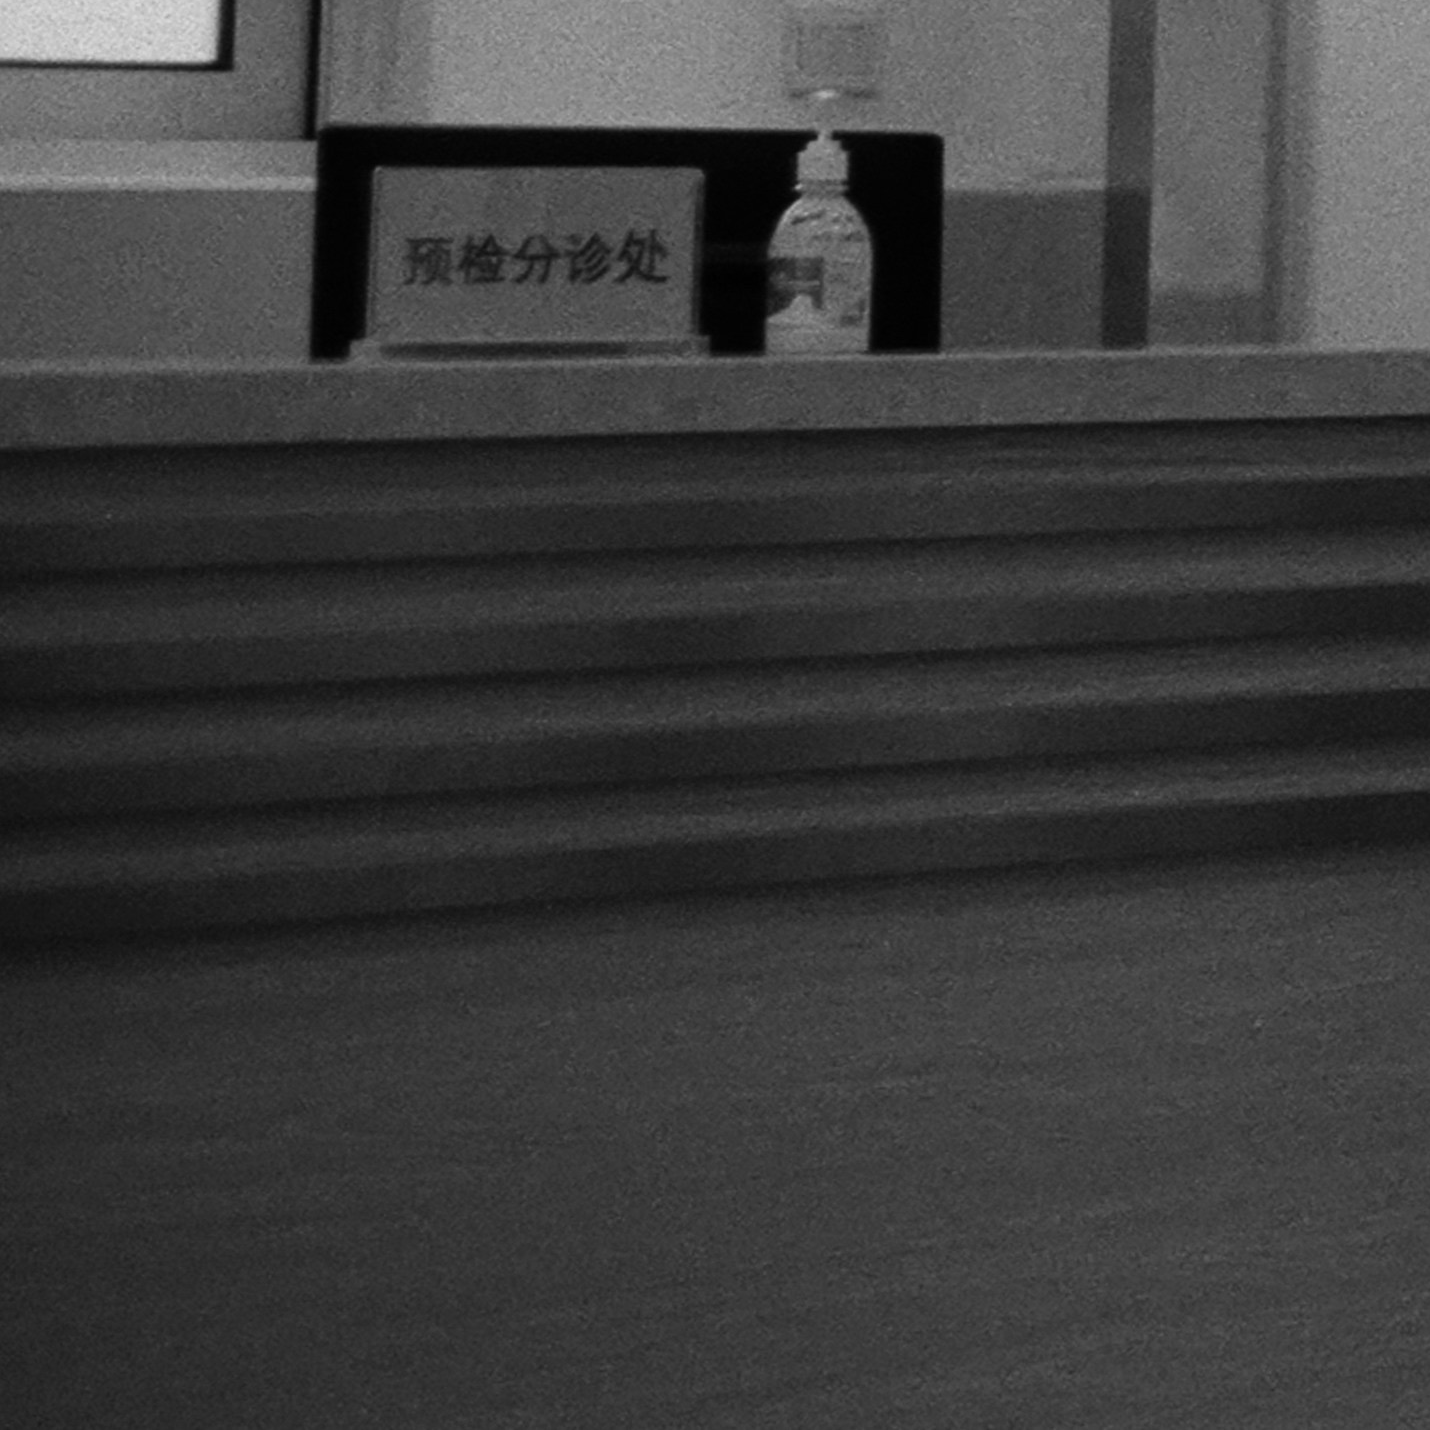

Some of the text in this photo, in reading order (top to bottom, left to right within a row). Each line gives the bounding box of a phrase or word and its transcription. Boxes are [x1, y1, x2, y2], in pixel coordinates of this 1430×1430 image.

[402, 228, 669, 287] 预检分诊处
